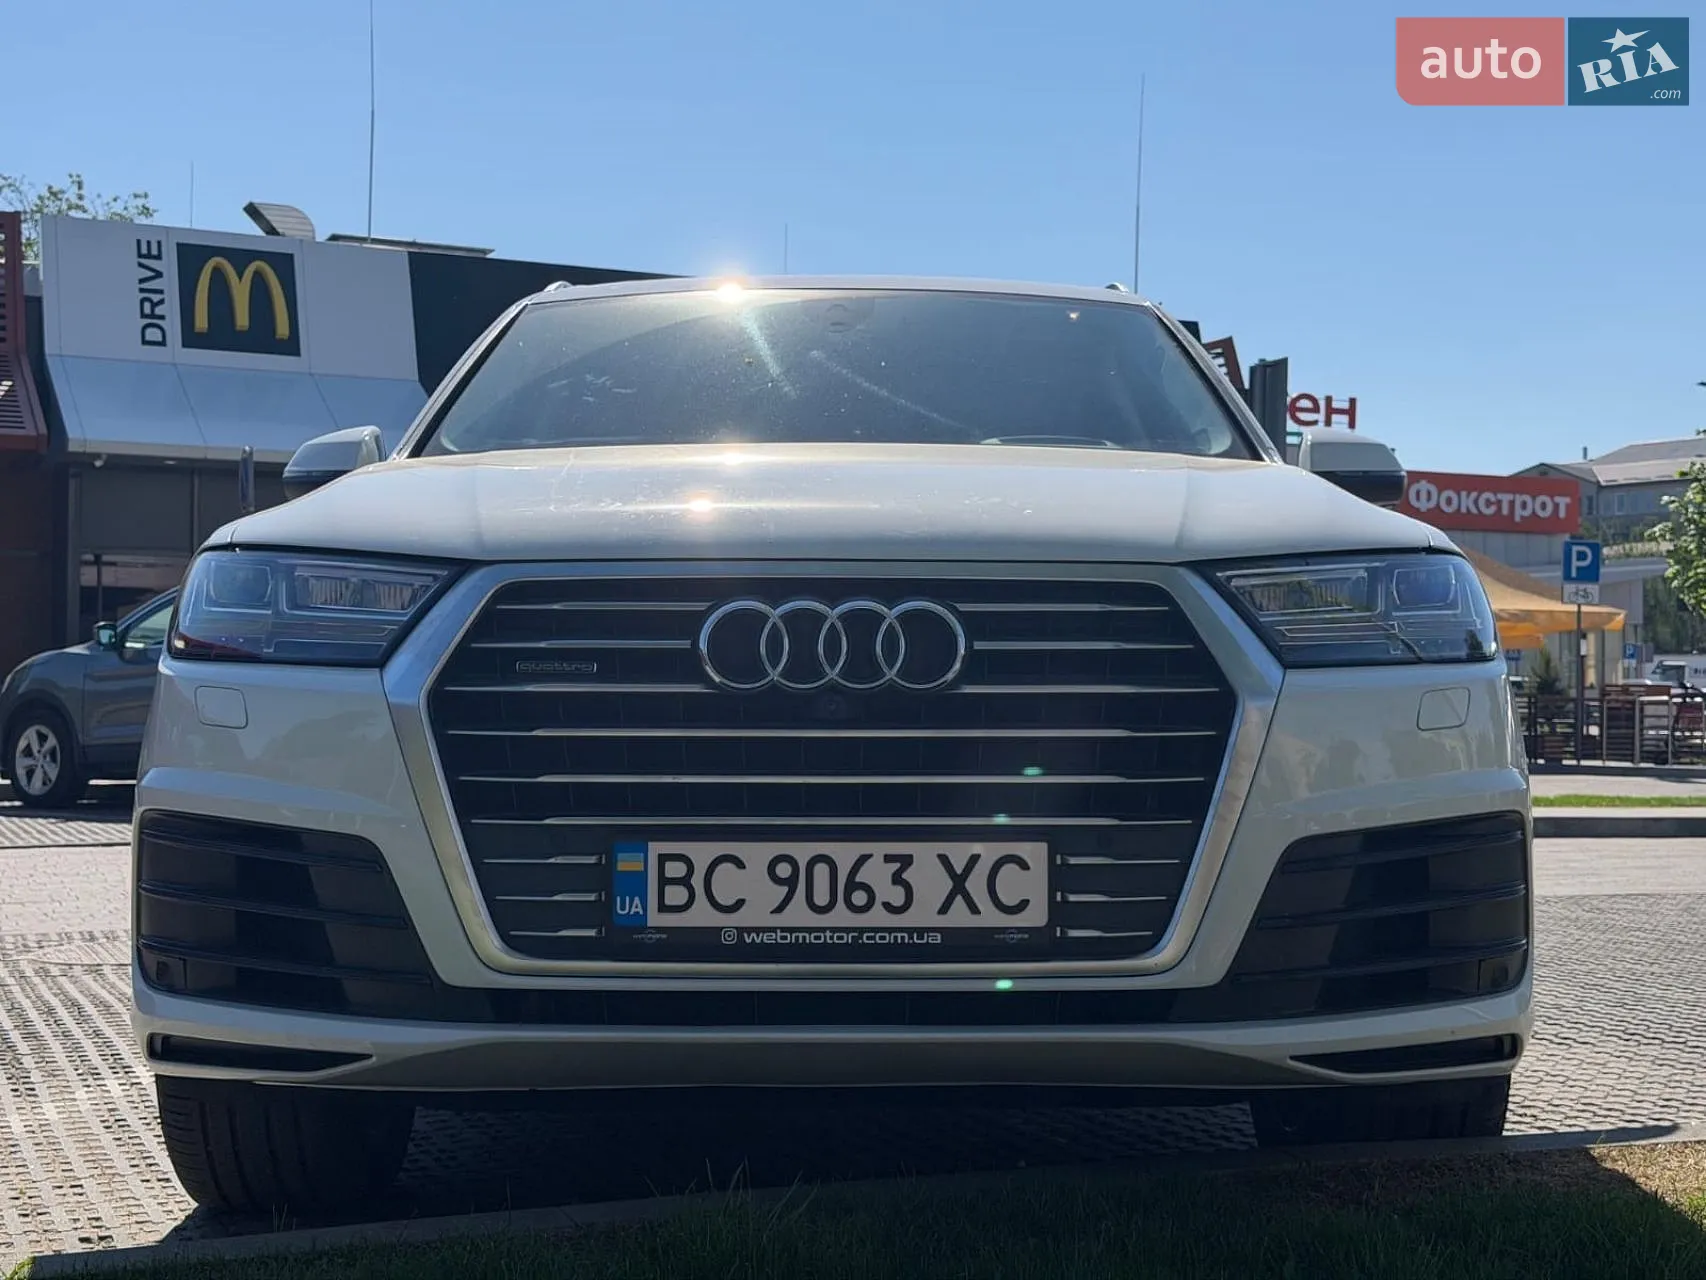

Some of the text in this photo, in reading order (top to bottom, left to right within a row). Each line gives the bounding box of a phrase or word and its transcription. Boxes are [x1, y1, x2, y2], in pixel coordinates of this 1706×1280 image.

[136, 238, 167, 347] DRIVE
[1408, 480, 1571, 522] Фокстрот
[1571, 545, 1593, 578] P
[519, 662, 594, 674] quattro
[657, 853, 1031, 915] BC 9063 XC
[616, 895, 644, 915] UA
[743, 929, 942, 944] webmotor.com.ua
